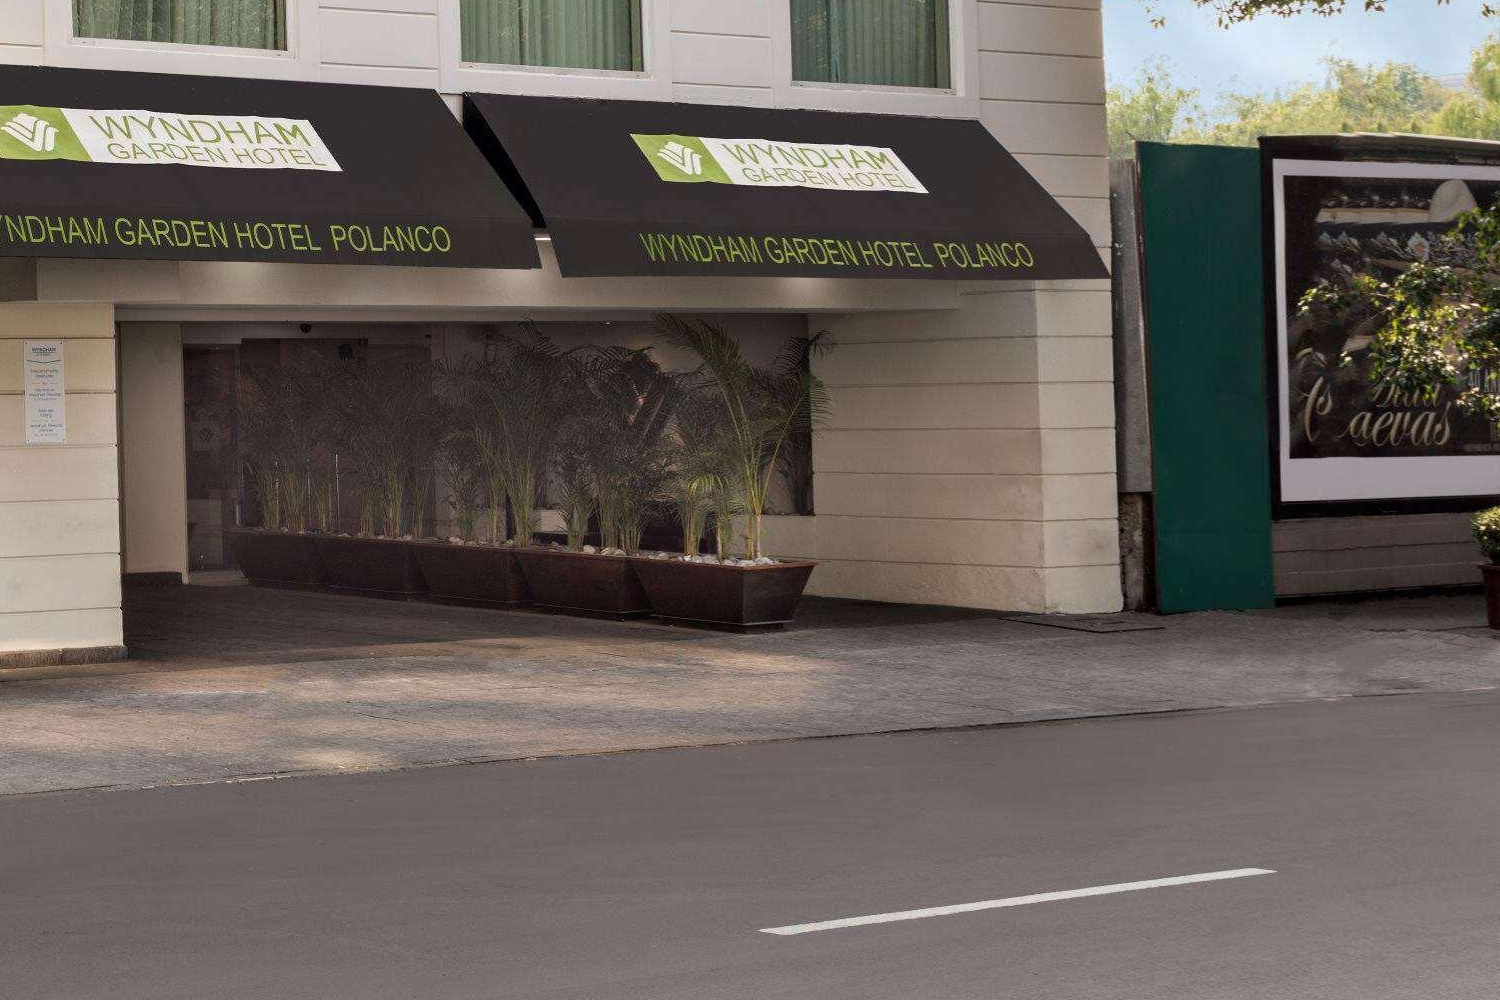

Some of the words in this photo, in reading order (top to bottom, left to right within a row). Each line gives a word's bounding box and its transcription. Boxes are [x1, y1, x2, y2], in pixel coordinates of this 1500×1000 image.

[88, 115, 313, 147] WYNDHAM
[107, 143, 228, 163] GARDEN
[230, 148, 327, 167] HOTEL
[722, 143, 900, 171] WYNDHAM
[742, 167, 837, 187] GARDEN
[838, 172, 915, 189] HOTEL
[115, 217, 228, 249] GARDEN
[236, 222, 322, 252] HOTEL
[330, 224, 452, 253] POLANCO
[638, 233, 761, 264] WYNDHAM
[764, 237, 860, 266] GARDEN
[860, 240, 932, 268] HOTEL
[934, 242, 1034, 268] POLANCO
